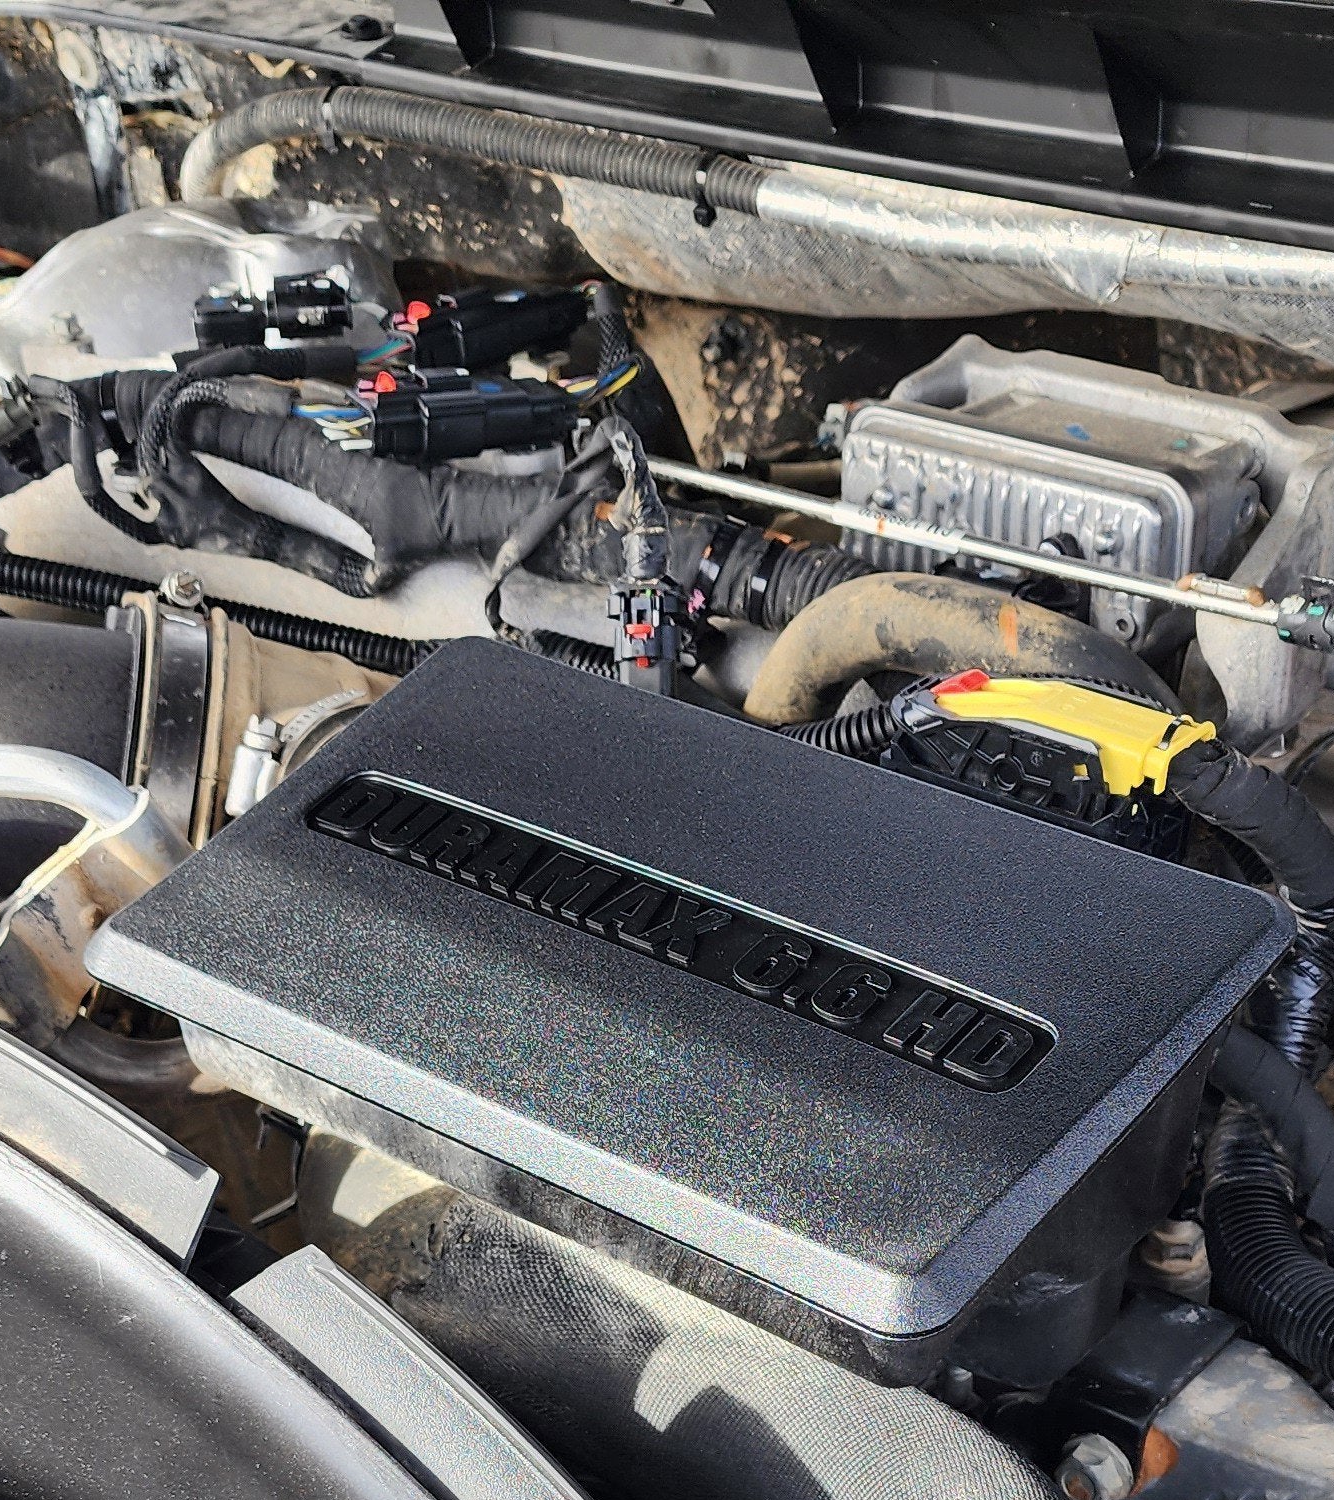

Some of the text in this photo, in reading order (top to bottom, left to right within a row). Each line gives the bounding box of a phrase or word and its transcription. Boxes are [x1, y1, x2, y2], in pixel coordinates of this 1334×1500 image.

[314, 781, 1035, 1079] DURAMAX 6.6 HD
